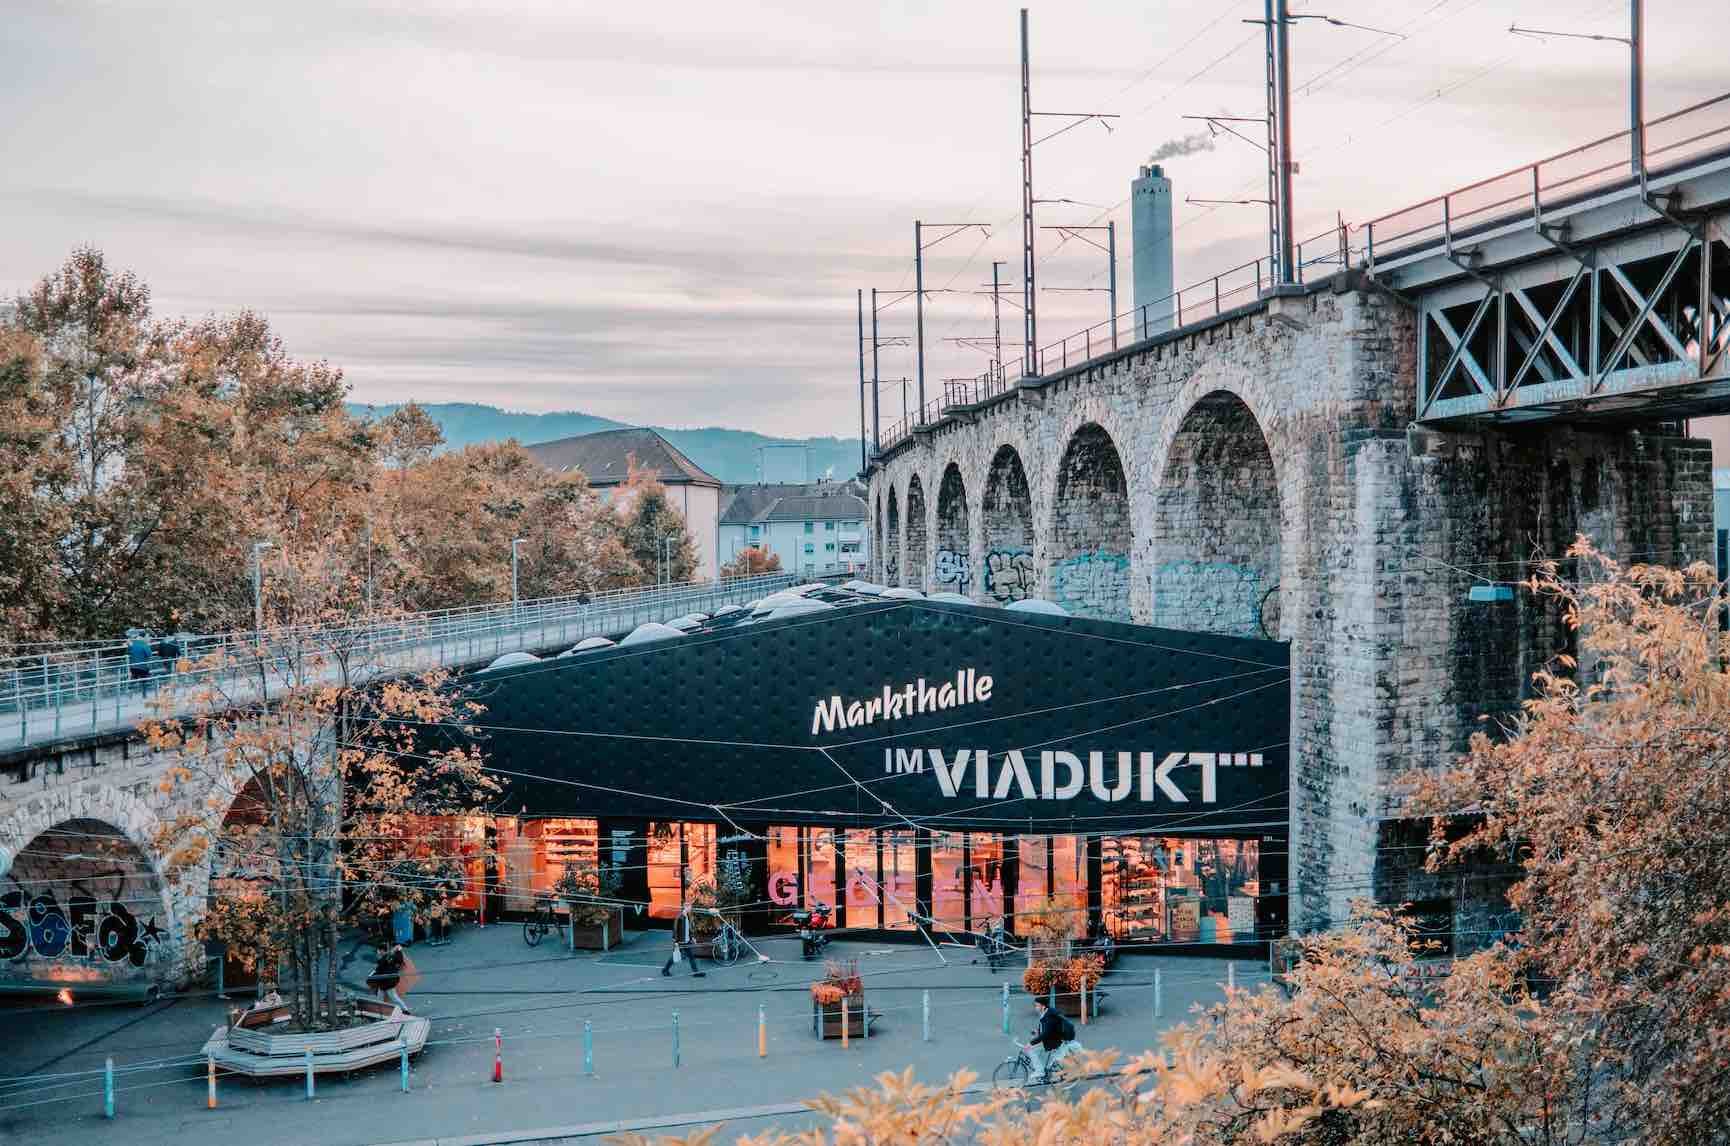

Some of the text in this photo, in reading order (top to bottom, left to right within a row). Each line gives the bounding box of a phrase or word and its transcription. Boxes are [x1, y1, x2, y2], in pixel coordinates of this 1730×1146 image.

[811, 668, 993, 735] Markthalle
[885, 748, 1217, 803] IM VIADUKT
